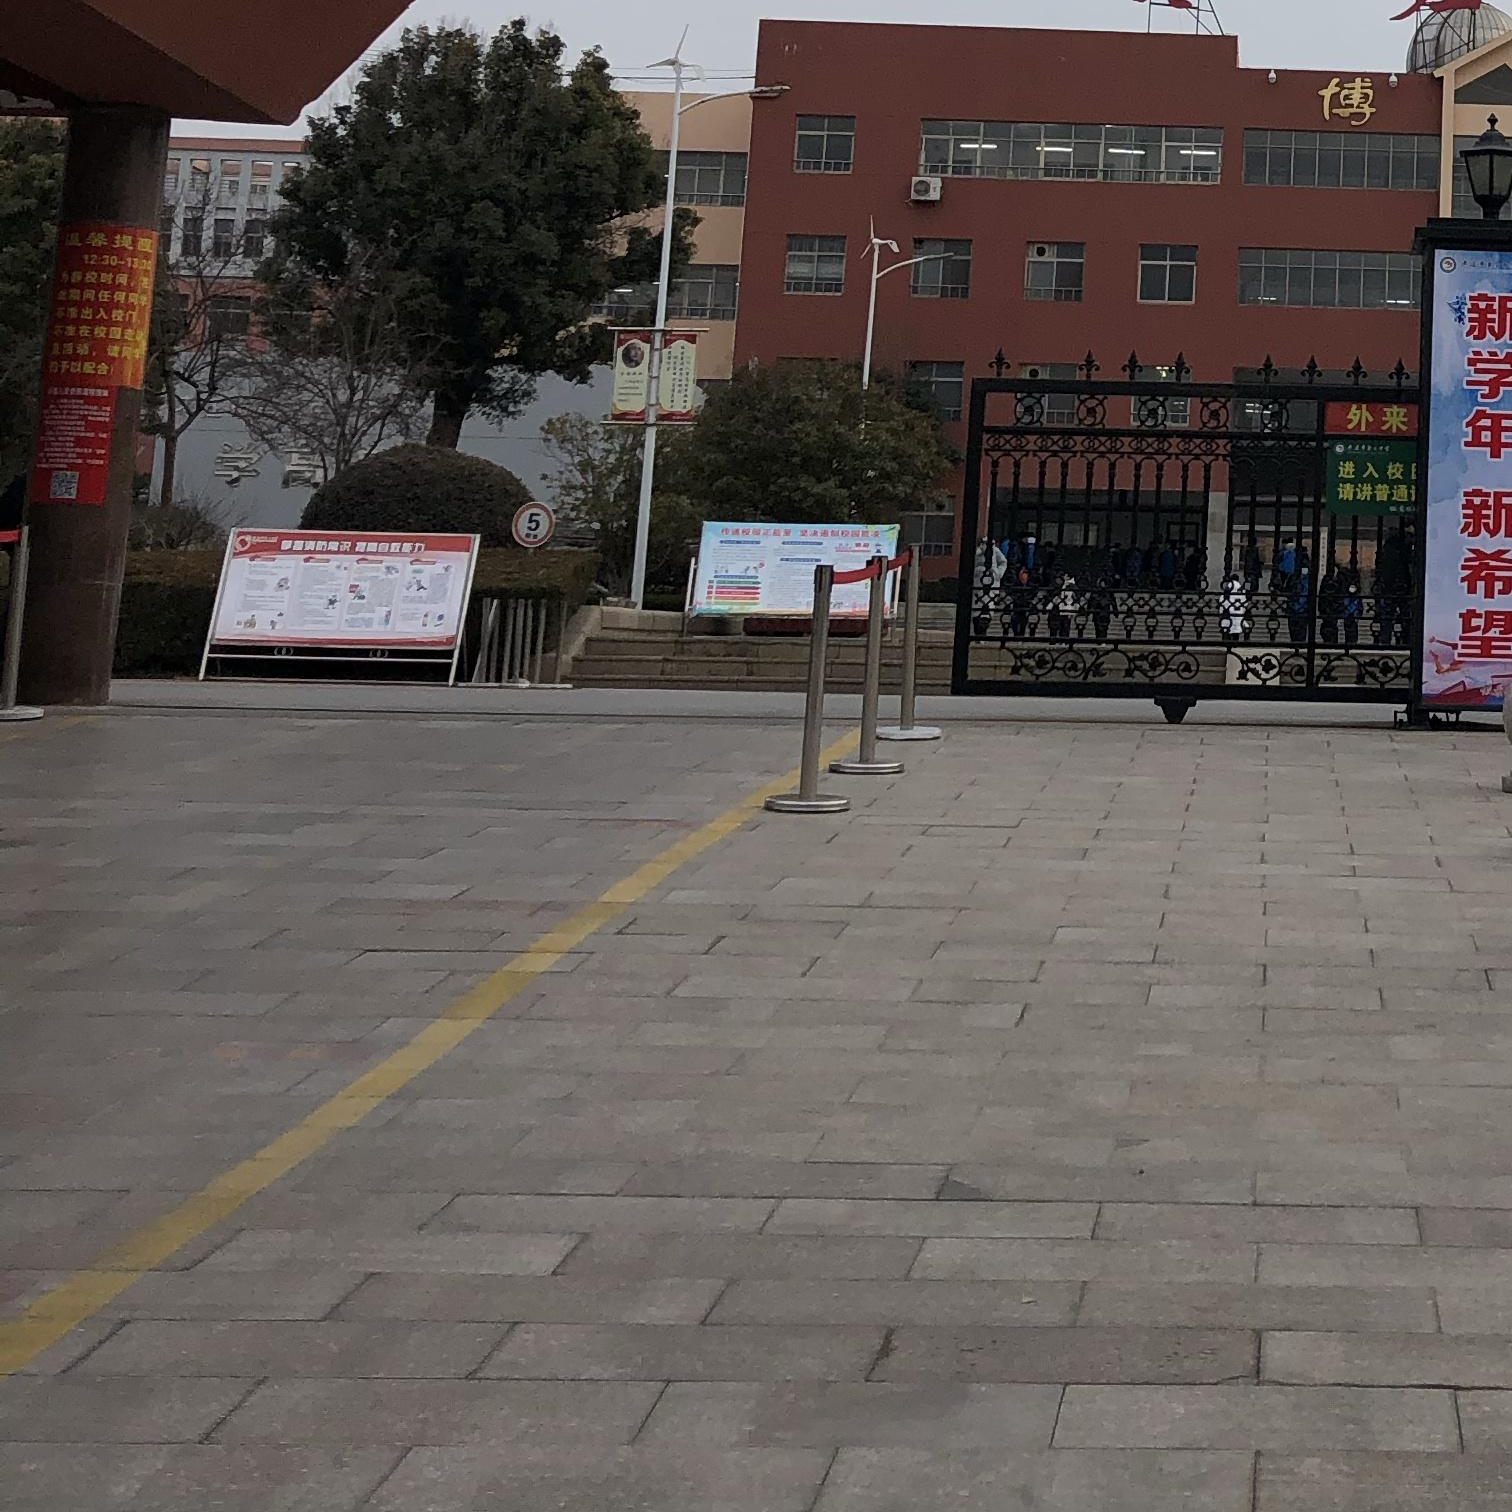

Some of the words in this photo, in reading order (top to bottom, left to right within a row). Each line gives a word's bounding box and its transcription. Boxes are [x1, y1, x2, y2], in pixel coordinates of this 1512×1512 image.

[1346, 403, 1408, 433] 外来
[1337, 461, 1416, 479] 进入校
[527, 513, 541, 531] 5
